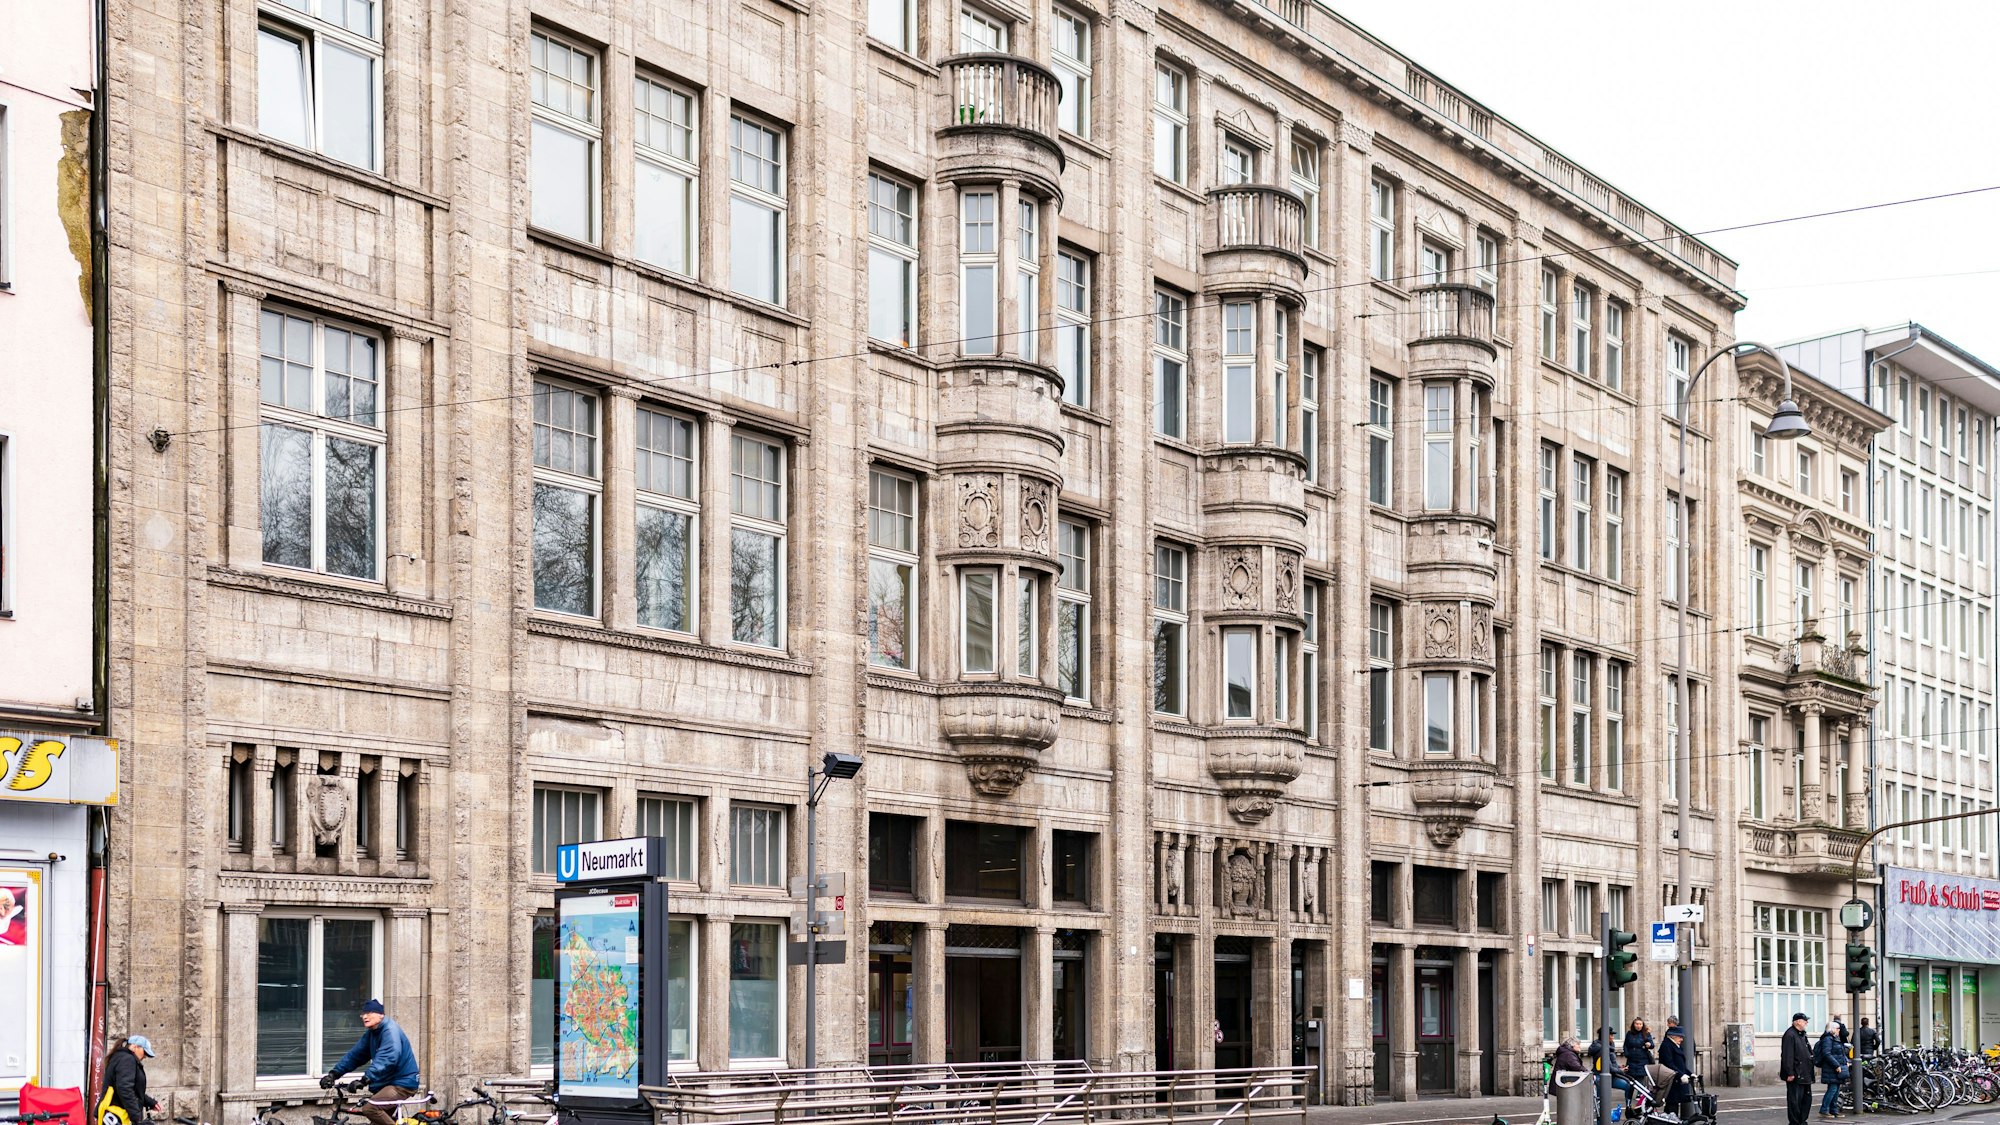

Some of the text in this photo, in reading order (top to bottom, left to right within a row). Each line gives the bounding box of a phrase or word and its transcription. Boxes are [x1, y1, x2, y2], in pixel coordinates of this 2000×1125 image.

[560, 850, 576, 878] U
[582, 847, 644, 871] Neumarkt
[1900, 880, 1980, 911] Fuß & Schuh
